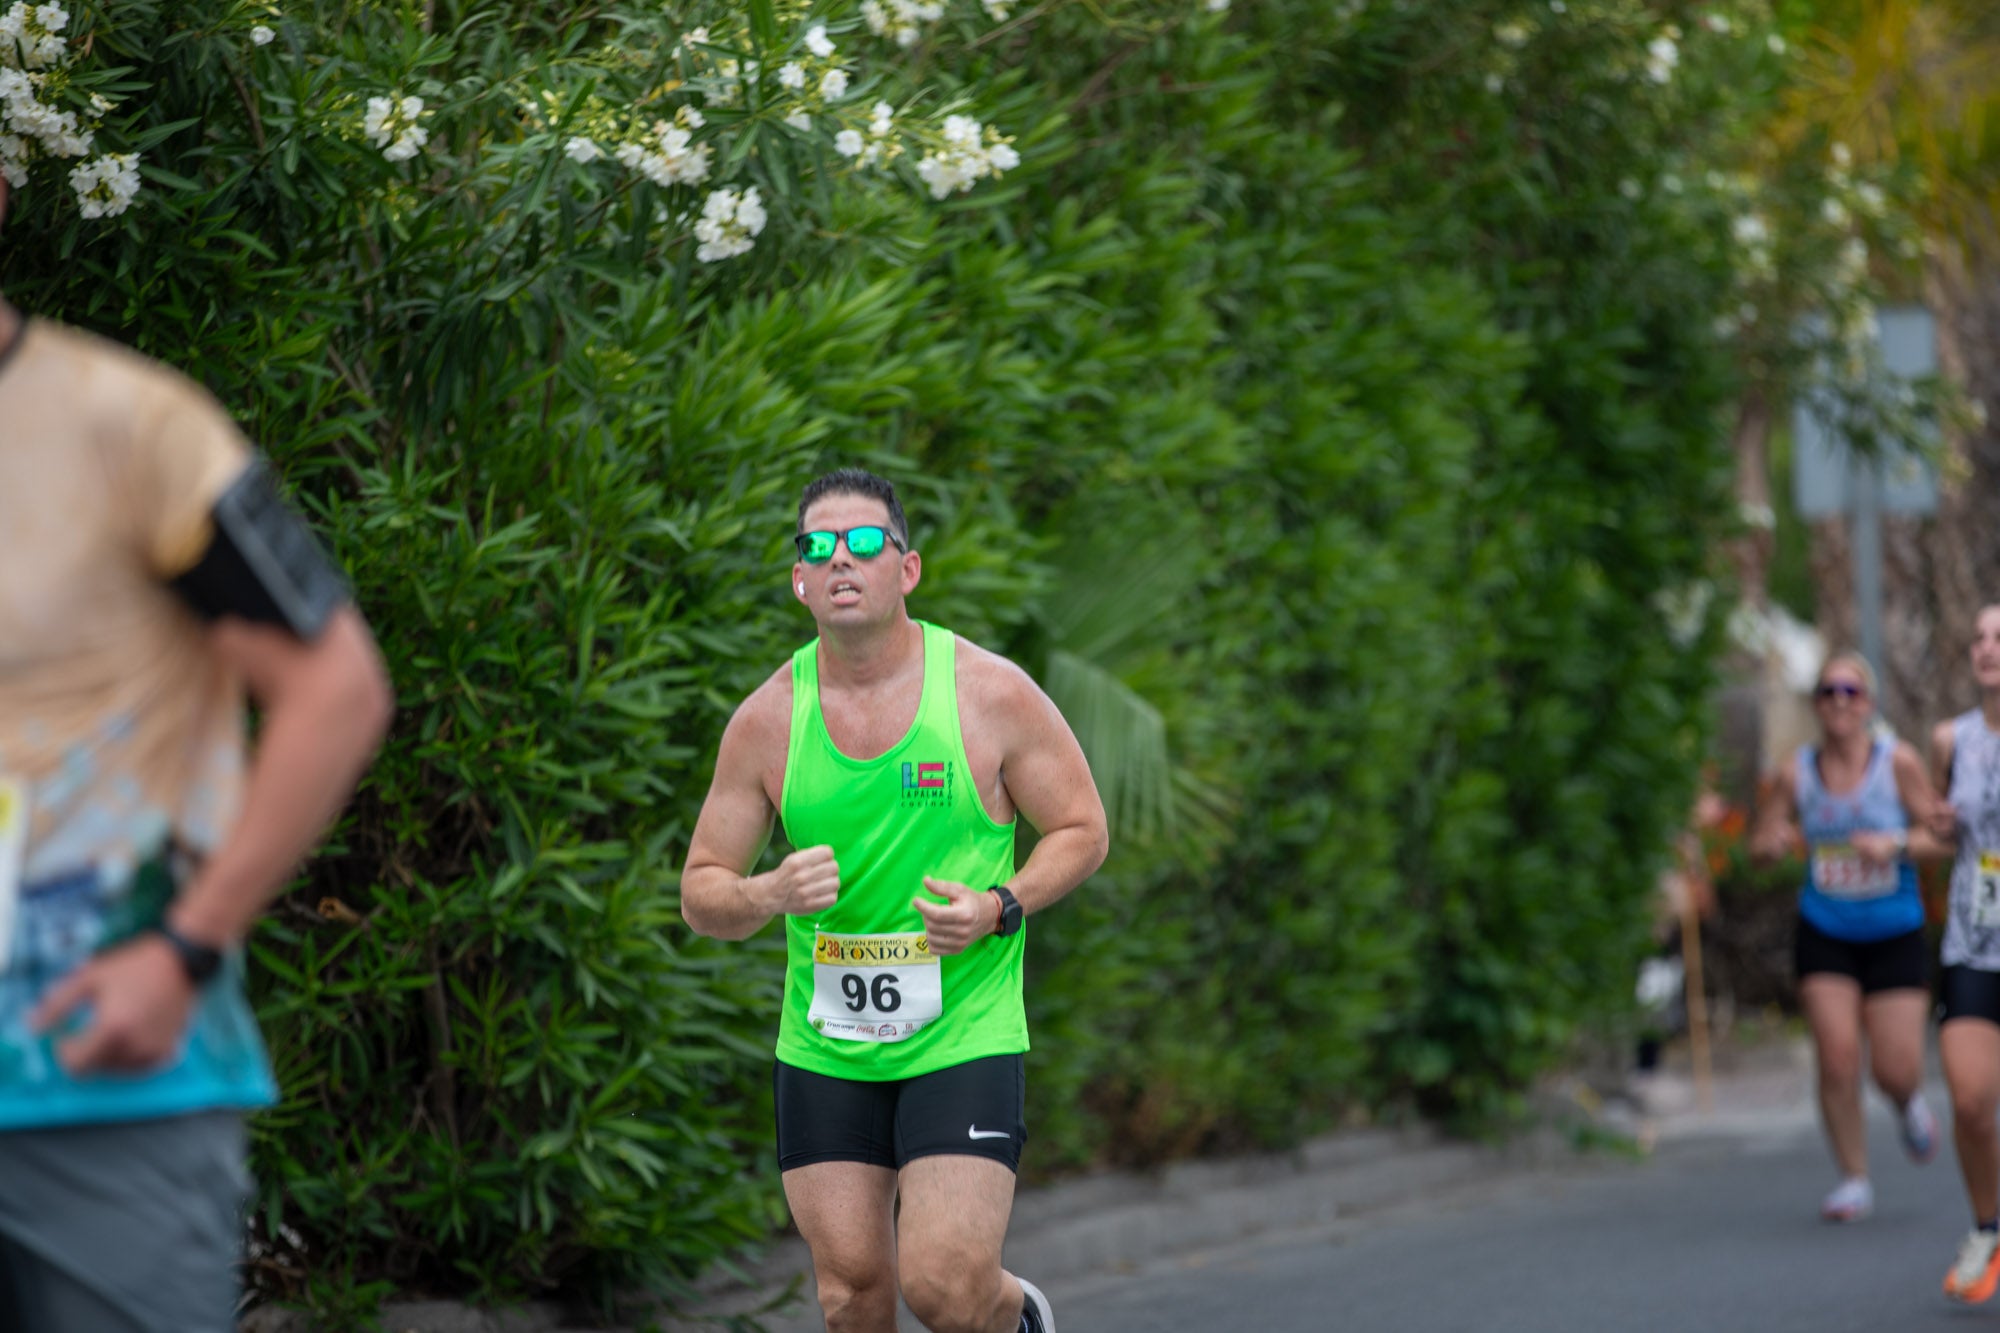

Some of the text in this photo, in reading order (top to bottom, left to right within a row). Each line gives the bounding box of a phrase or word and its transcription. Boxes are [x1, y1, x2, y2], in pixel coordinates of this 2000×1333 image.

[827, 940, 840, 959] 38
[842, 939, 866, 947] GRAN
[868, 938, 902, 947] PREMIO
[840, 946, 909, 960] FONDO
[841, 973, 902, 1013] 96
